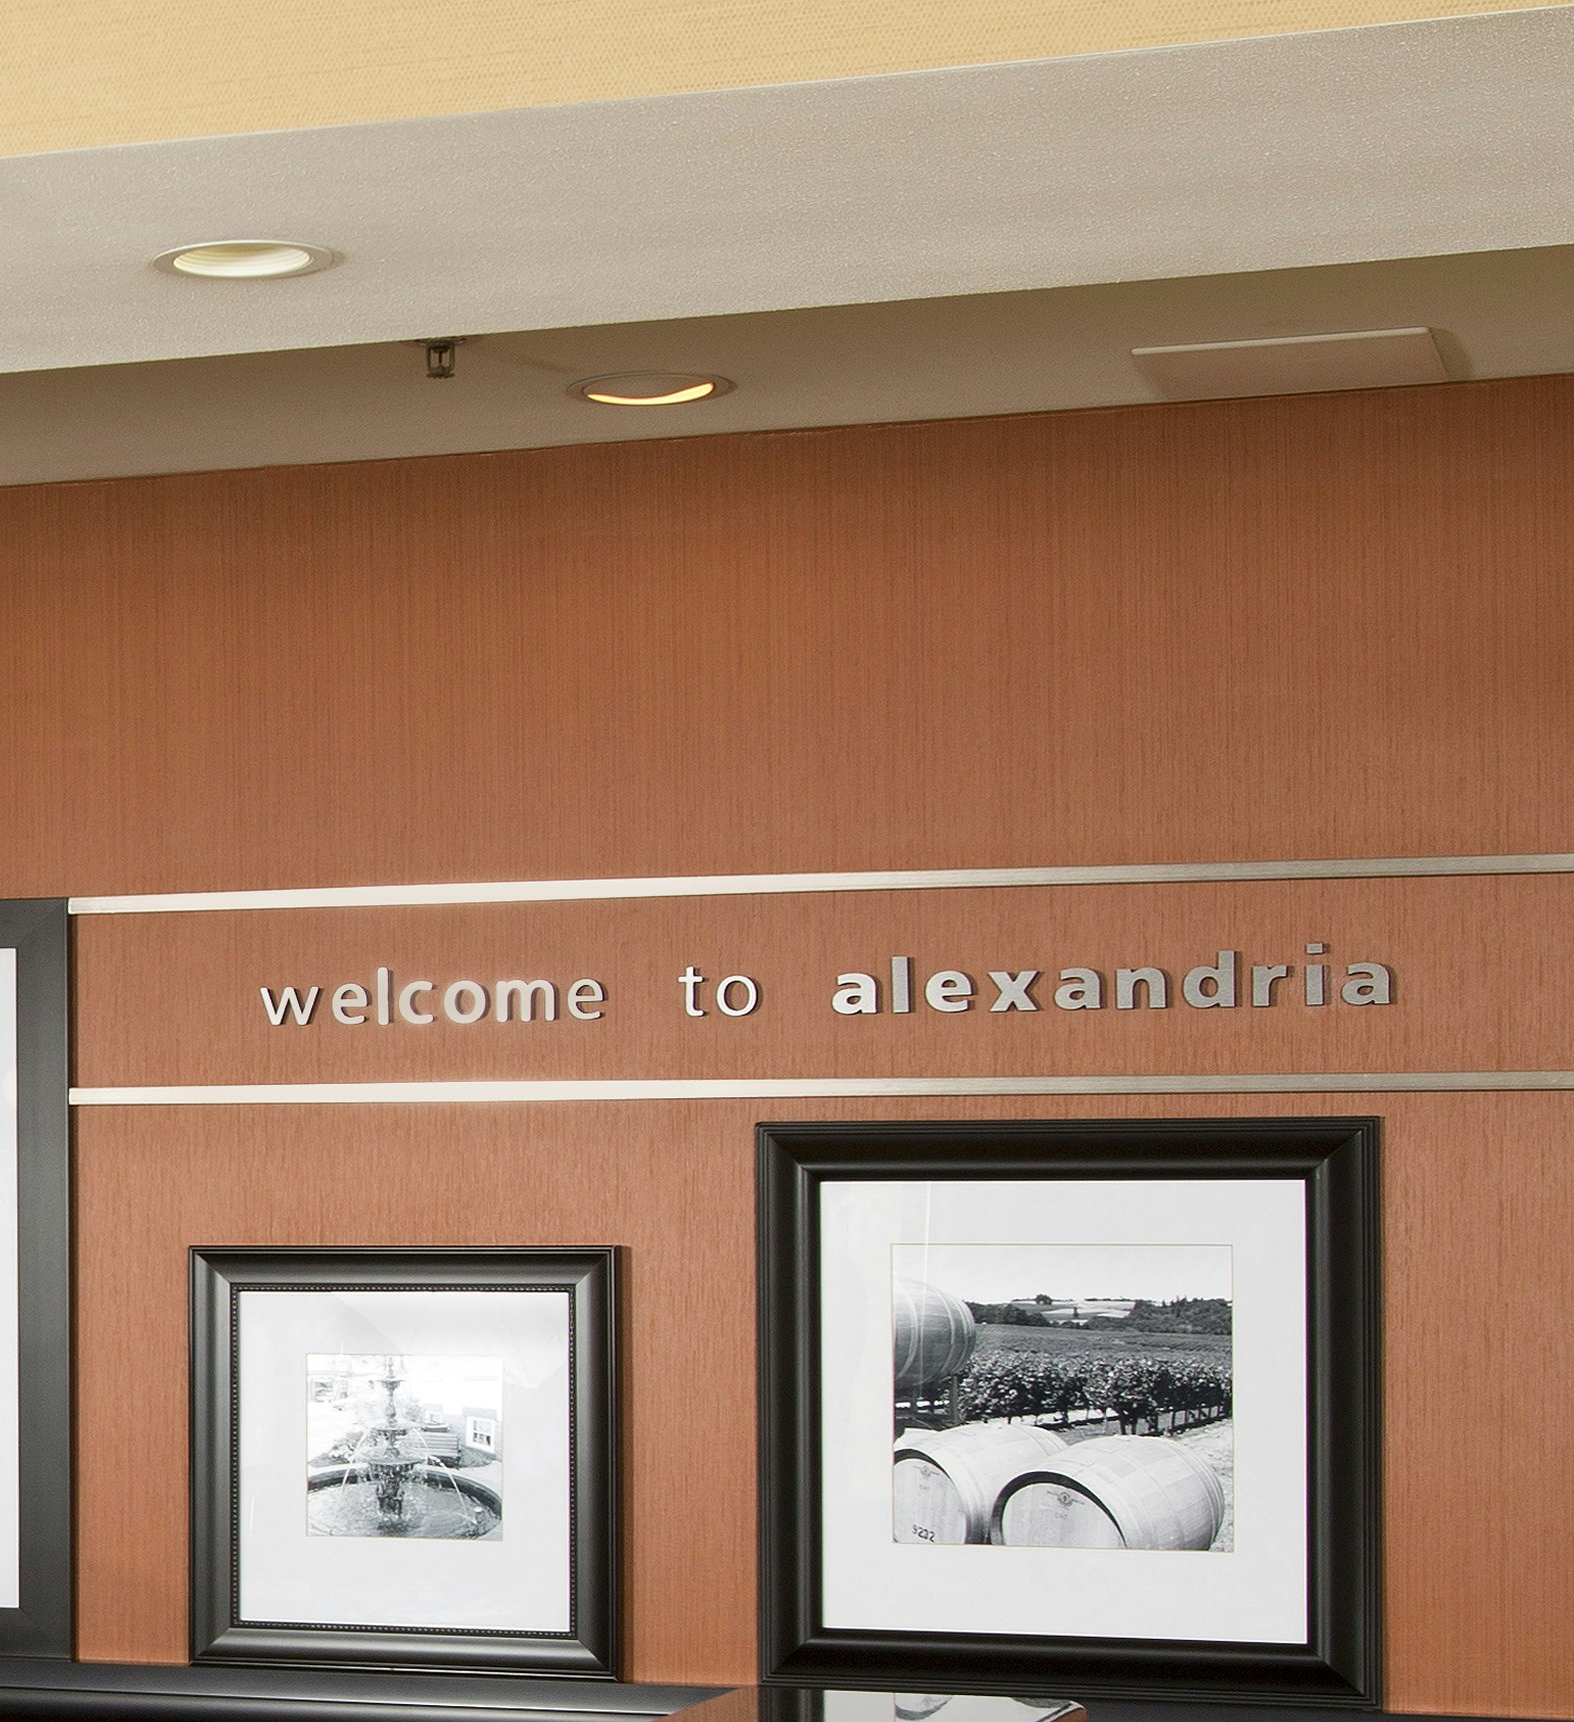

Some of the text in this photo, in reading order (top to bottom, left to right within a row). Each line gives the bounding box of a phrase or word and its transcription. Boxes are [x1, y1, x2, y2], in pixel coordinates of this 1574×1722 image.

[260, 942, 1392, 1027] welcome to alexandria
